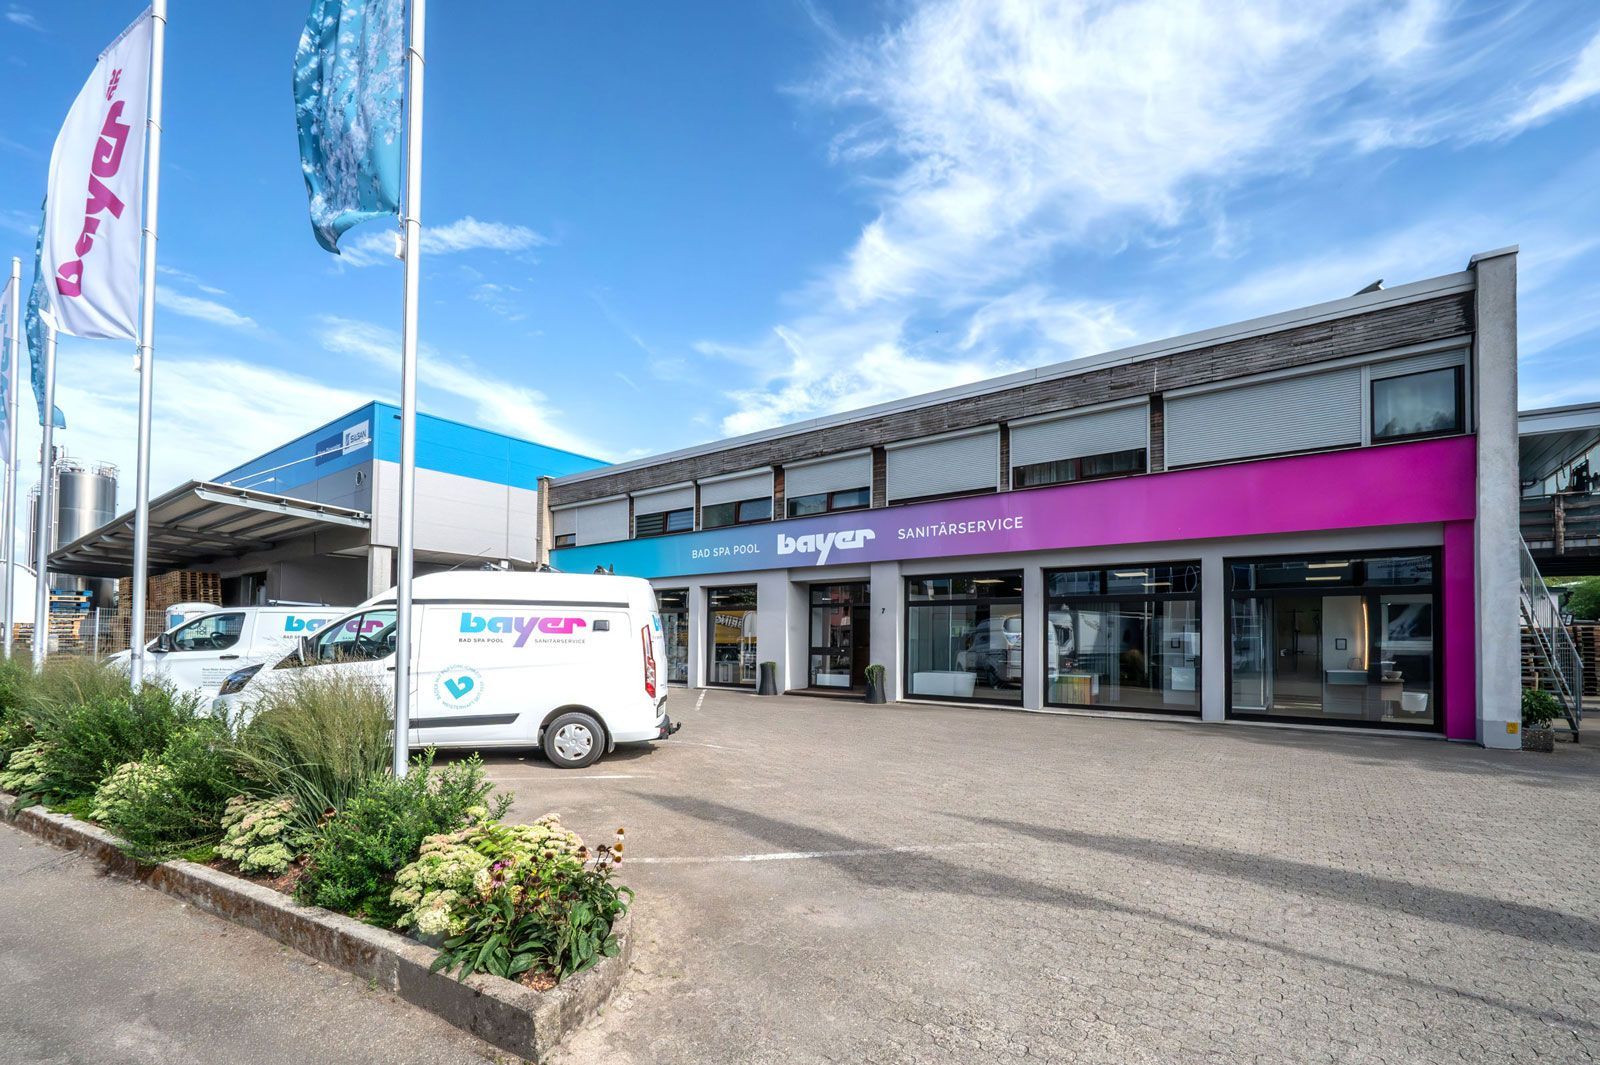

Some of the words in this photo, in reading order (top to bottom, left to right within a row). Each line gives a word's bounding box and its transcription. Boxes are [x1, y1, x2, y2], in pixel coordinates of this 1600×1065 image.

[897, 516, 1024, 540] SANITÄRSERVICE
[692, 549, 710, 559] BAD
[713, 547, 731, 558] SPA
[733, 544, 760, 555] POOL
[777, 528, 876, 566] bayer
[459, 612, 587, 648] bayer
